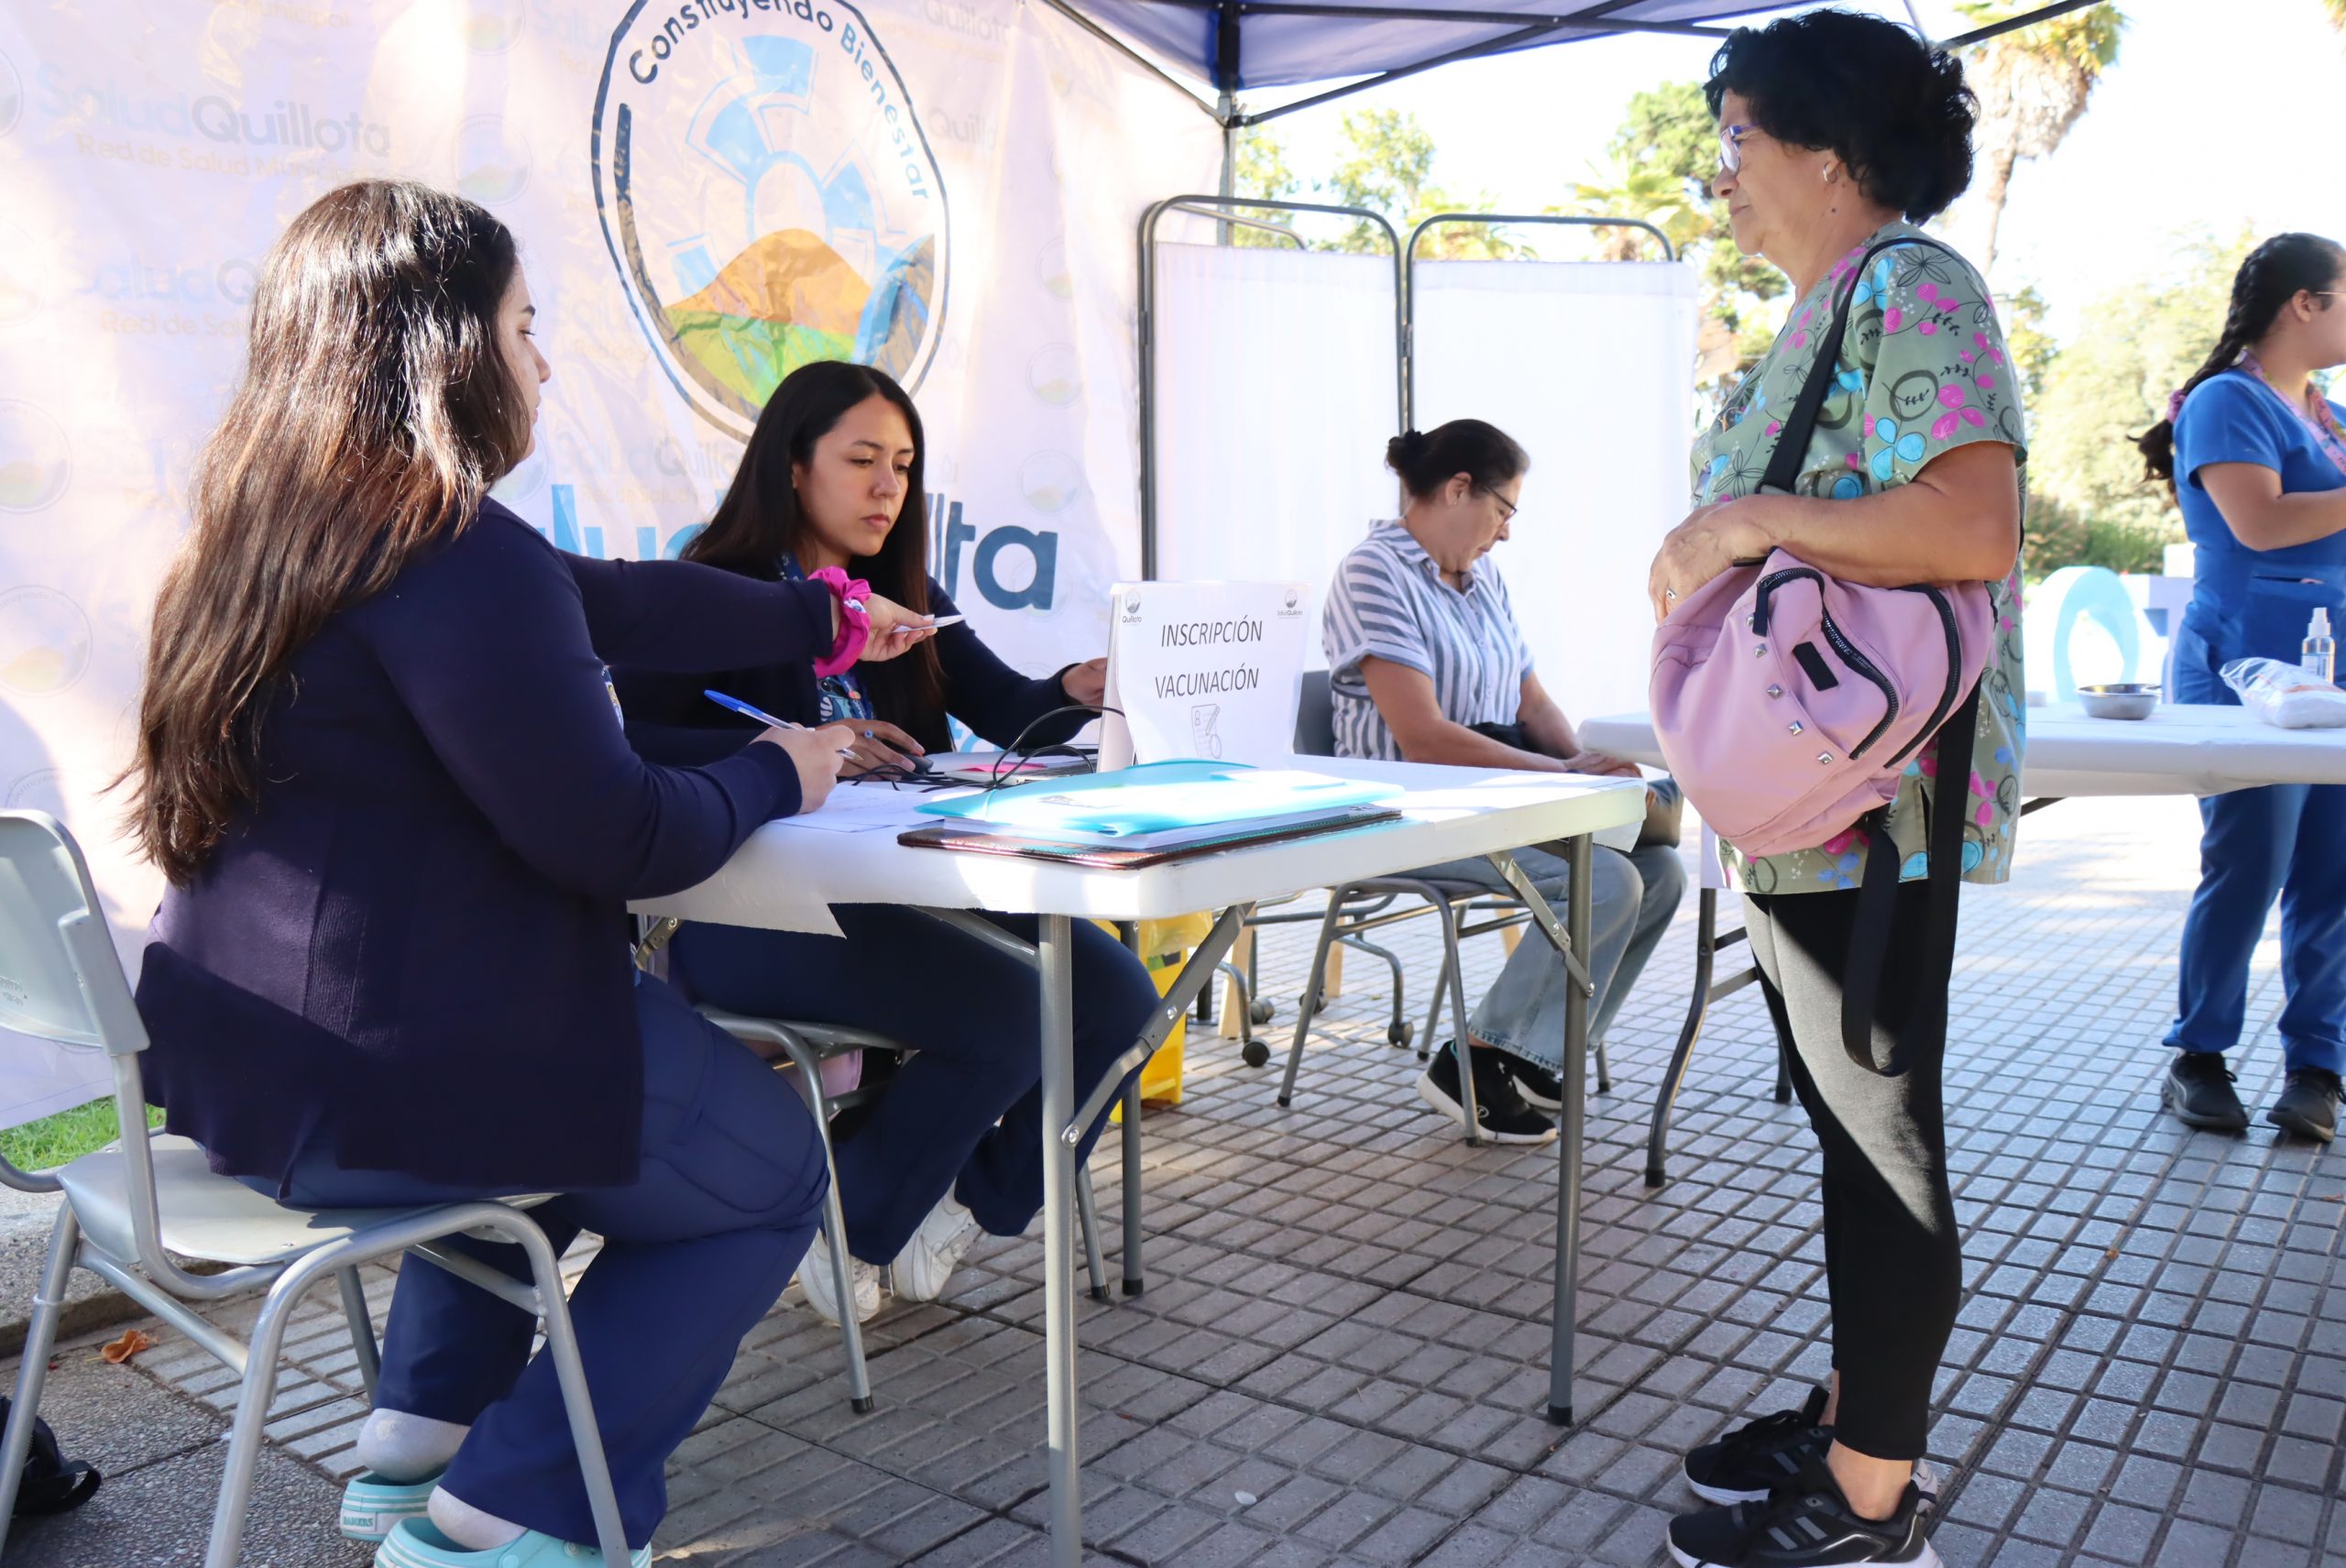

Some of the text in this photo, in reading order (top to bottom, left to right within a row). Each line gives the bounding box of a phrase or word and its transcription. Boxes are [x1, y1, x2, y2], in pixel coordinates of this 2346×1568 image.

[36, 61, 391, 158] SaludQuillota
[839, 23, 928, 201] Bienestar
[75, 133, 133, 162] Red
[138, 141, 171, 168] de
[178, 148, 250, 177] Salud
[101, 310, 157, 334] Red
[162, 313, 198, 337] de
[1161, 615, 1263, 647] INSCRIPCIÓN
[1156, 663, 1260, 699] VACUNACIÓN
